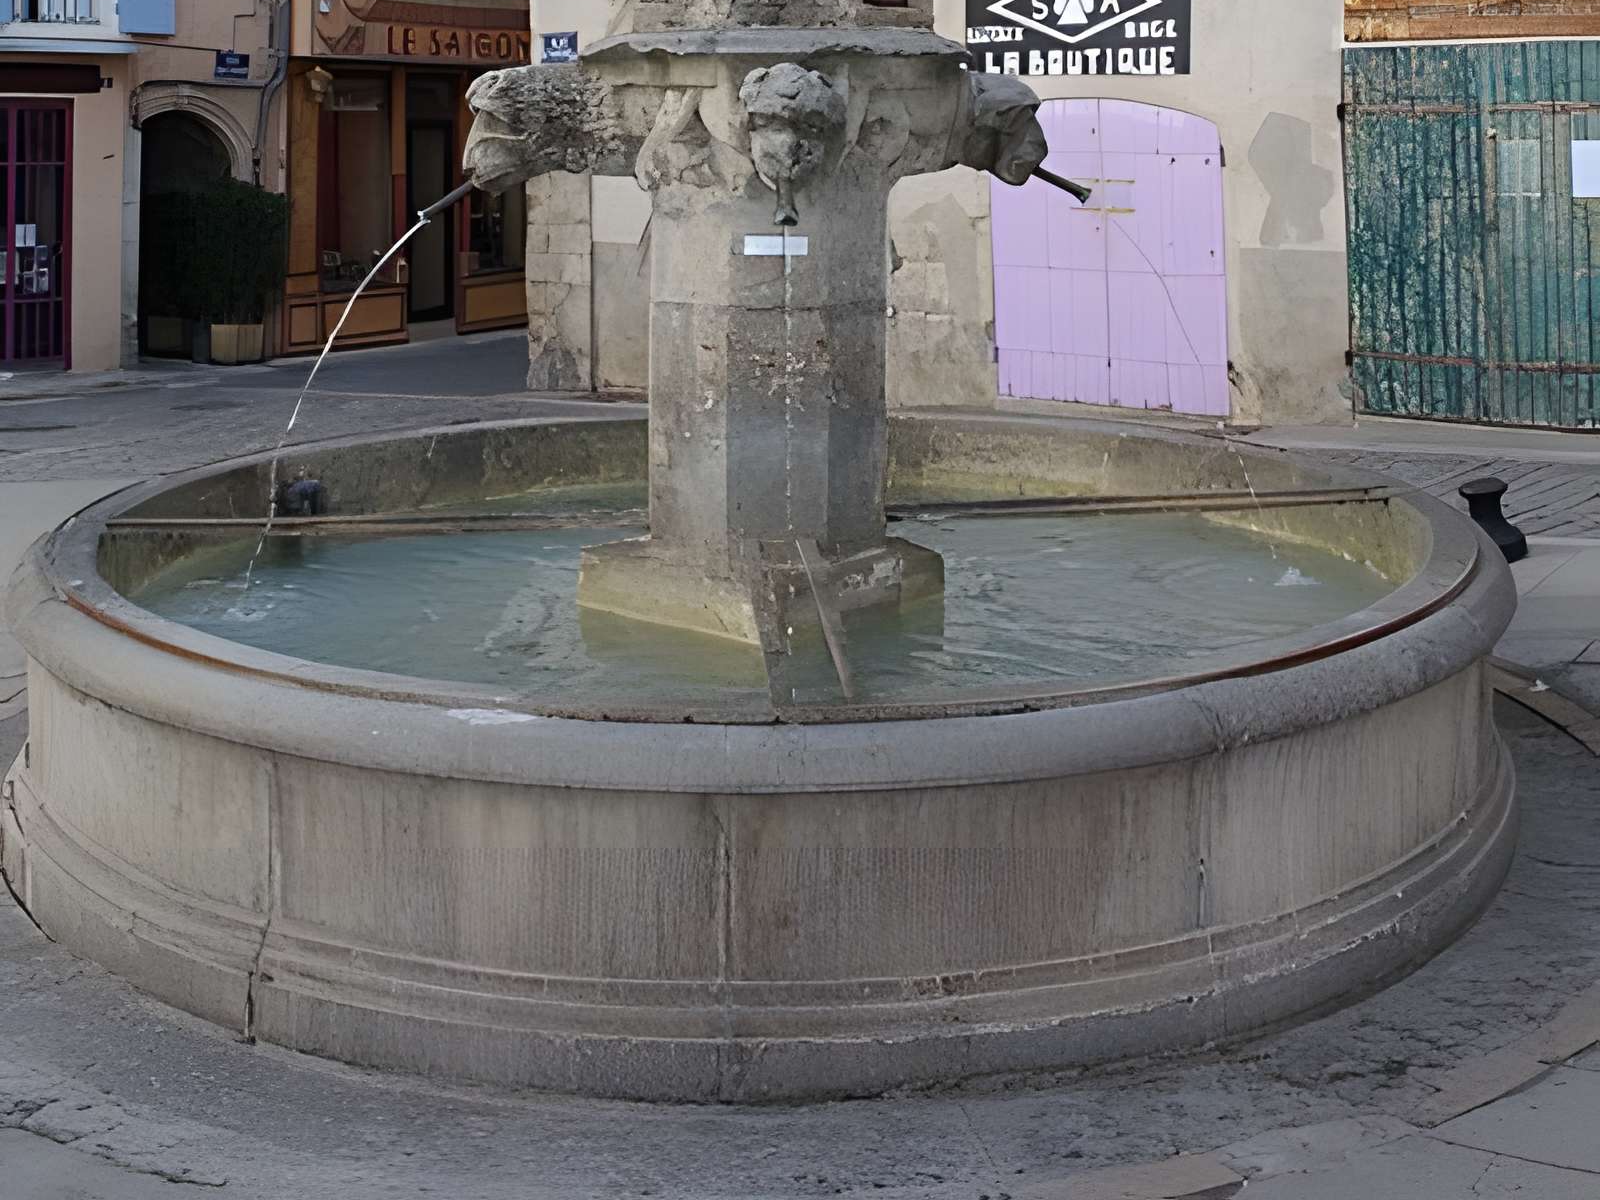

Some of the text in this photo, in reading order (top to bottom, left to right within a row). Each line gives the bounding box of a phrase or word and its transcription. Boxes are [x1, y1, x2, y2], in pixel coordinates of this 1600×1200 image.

[387, 25, 417, 56] LE
[429, 27, 531, 64] SAIGON
[1028, 45, 1176, 75] BOUTIQUE
